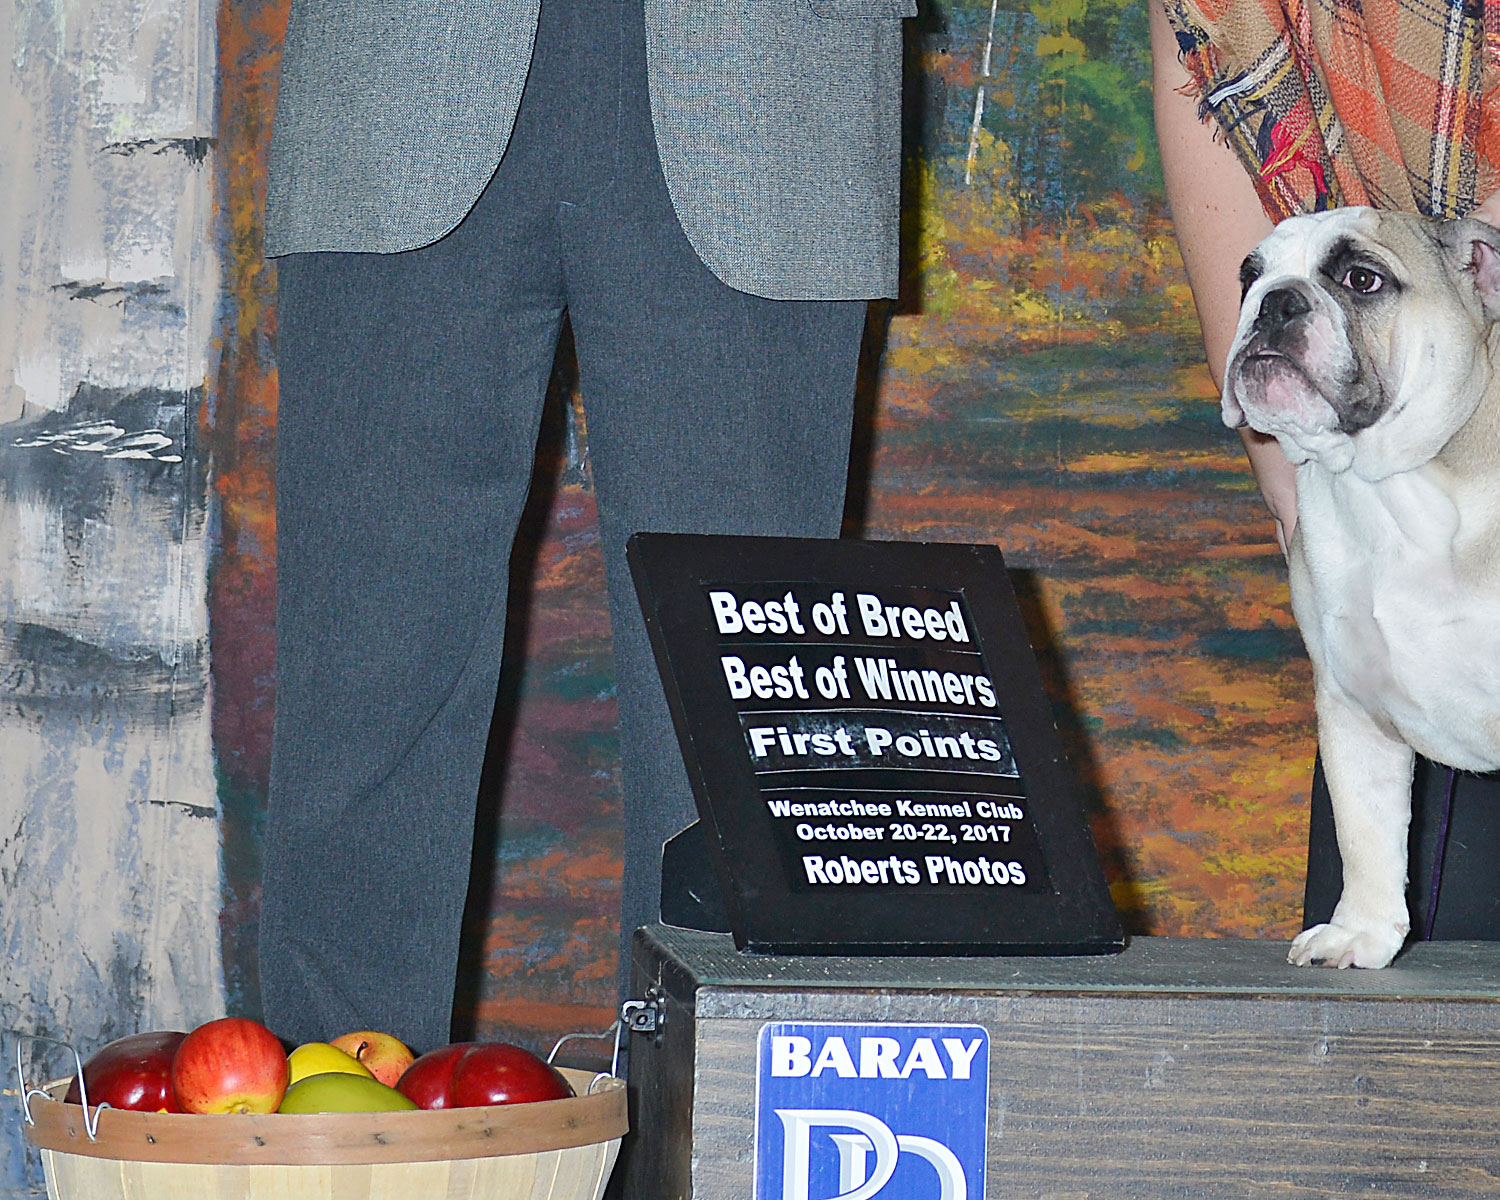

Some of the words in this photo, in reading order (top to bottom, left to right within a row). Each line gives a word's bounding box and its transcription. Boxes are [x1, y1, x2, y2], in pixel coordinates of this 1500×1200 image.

[710, 591, 805, 634] Best
[812, 592, 849, 635] of
[857, 594, 970, 643] Breed
[721, 656, 809, 699] Best
[815, 656, 850, 699] of
[854, 657, 997, 708] Winners
[748, 726, 857, 758] First
[865, 728, 1002, 762] Points
[767, 800, 892, 818] Wenatchee
[896, 799, 973, 818] Kennel
[976, 801, 1024, 820] Club
[796, 823, 885, 841] October
[889, 823, 958, 845] 20-22,
[959, 824, 1011, 842] 2017
[802, 855, 920, 885] Roberts
[925, 855, 1026, 885] Photos
[771, 1035, 984, 1080] BARAY
